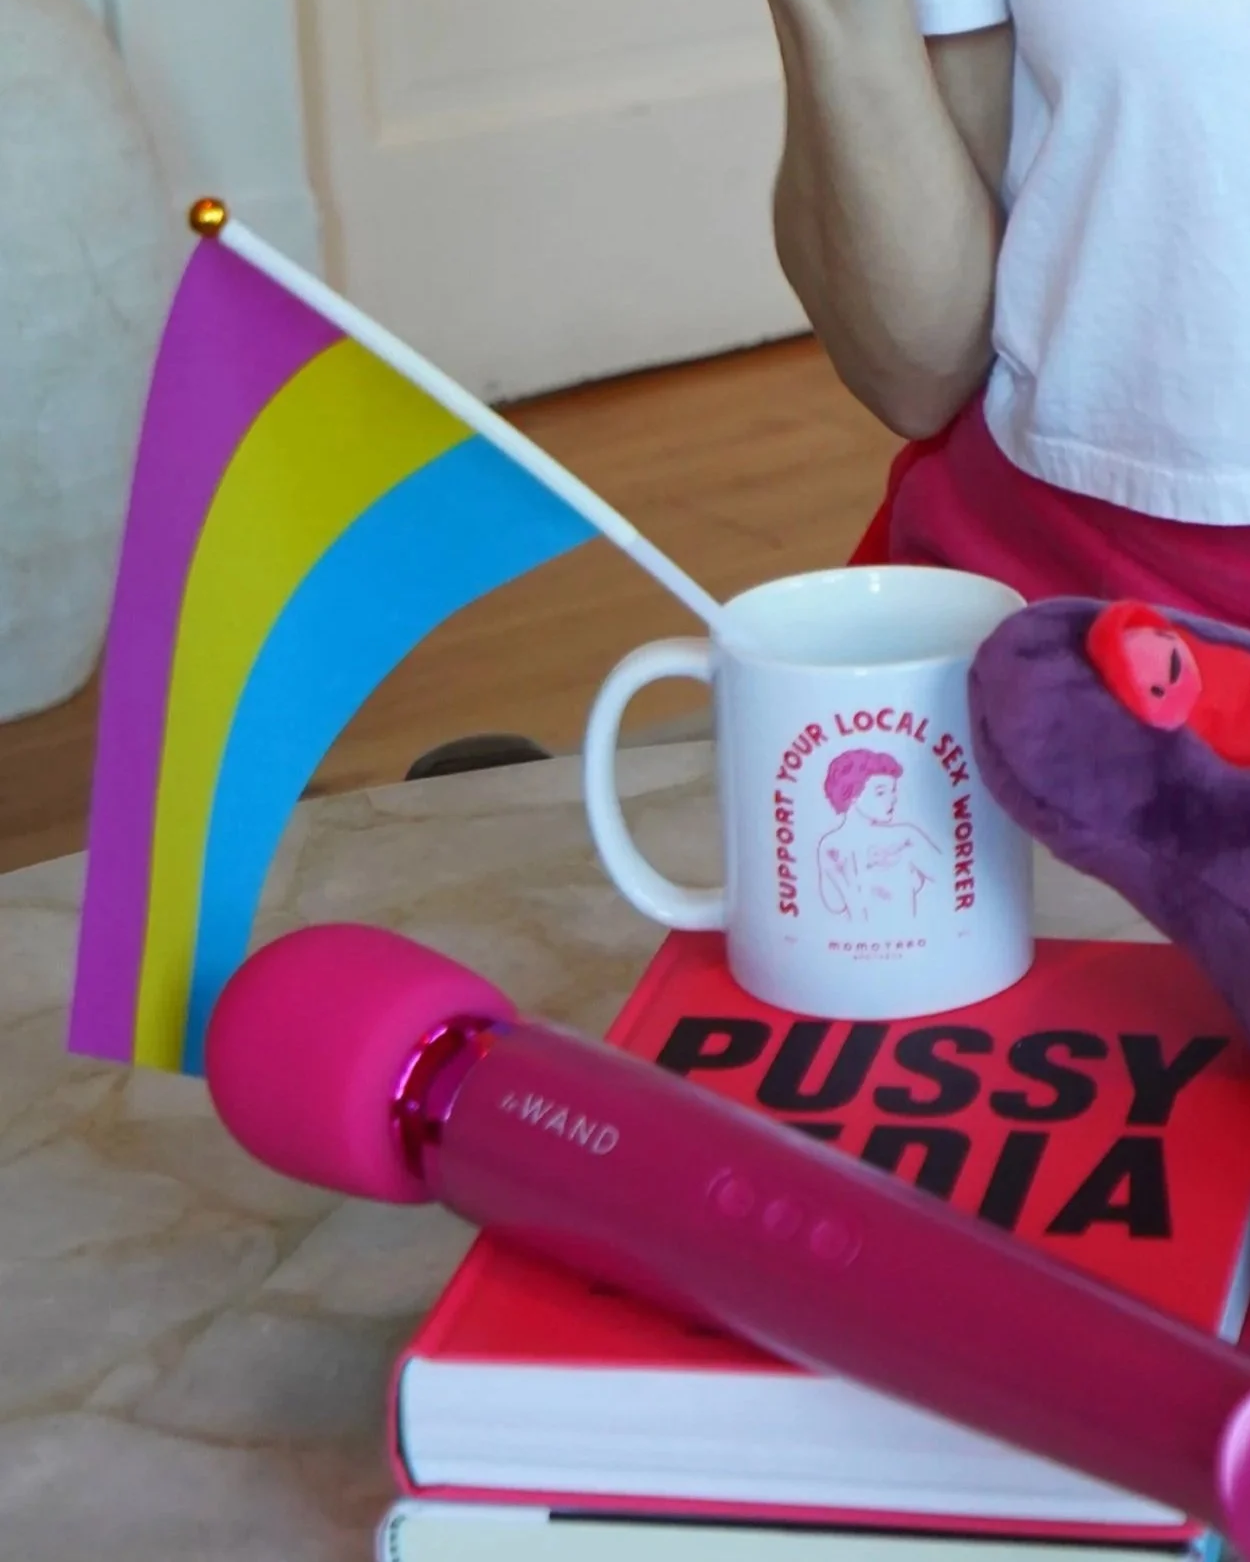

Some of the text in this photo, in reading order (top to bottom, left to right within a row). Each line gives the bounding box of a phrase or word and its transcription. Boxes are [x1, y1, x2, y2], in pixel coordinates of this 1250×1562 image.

[774, 707, 975, 918] SUPPORT YOUR LOCAL SEX WORKER
[521, 1092, 620, 1156] WAND
[655, 1016, 1230, 1127] PUSSY
[780, 1121, 1173, 1239] DIA
